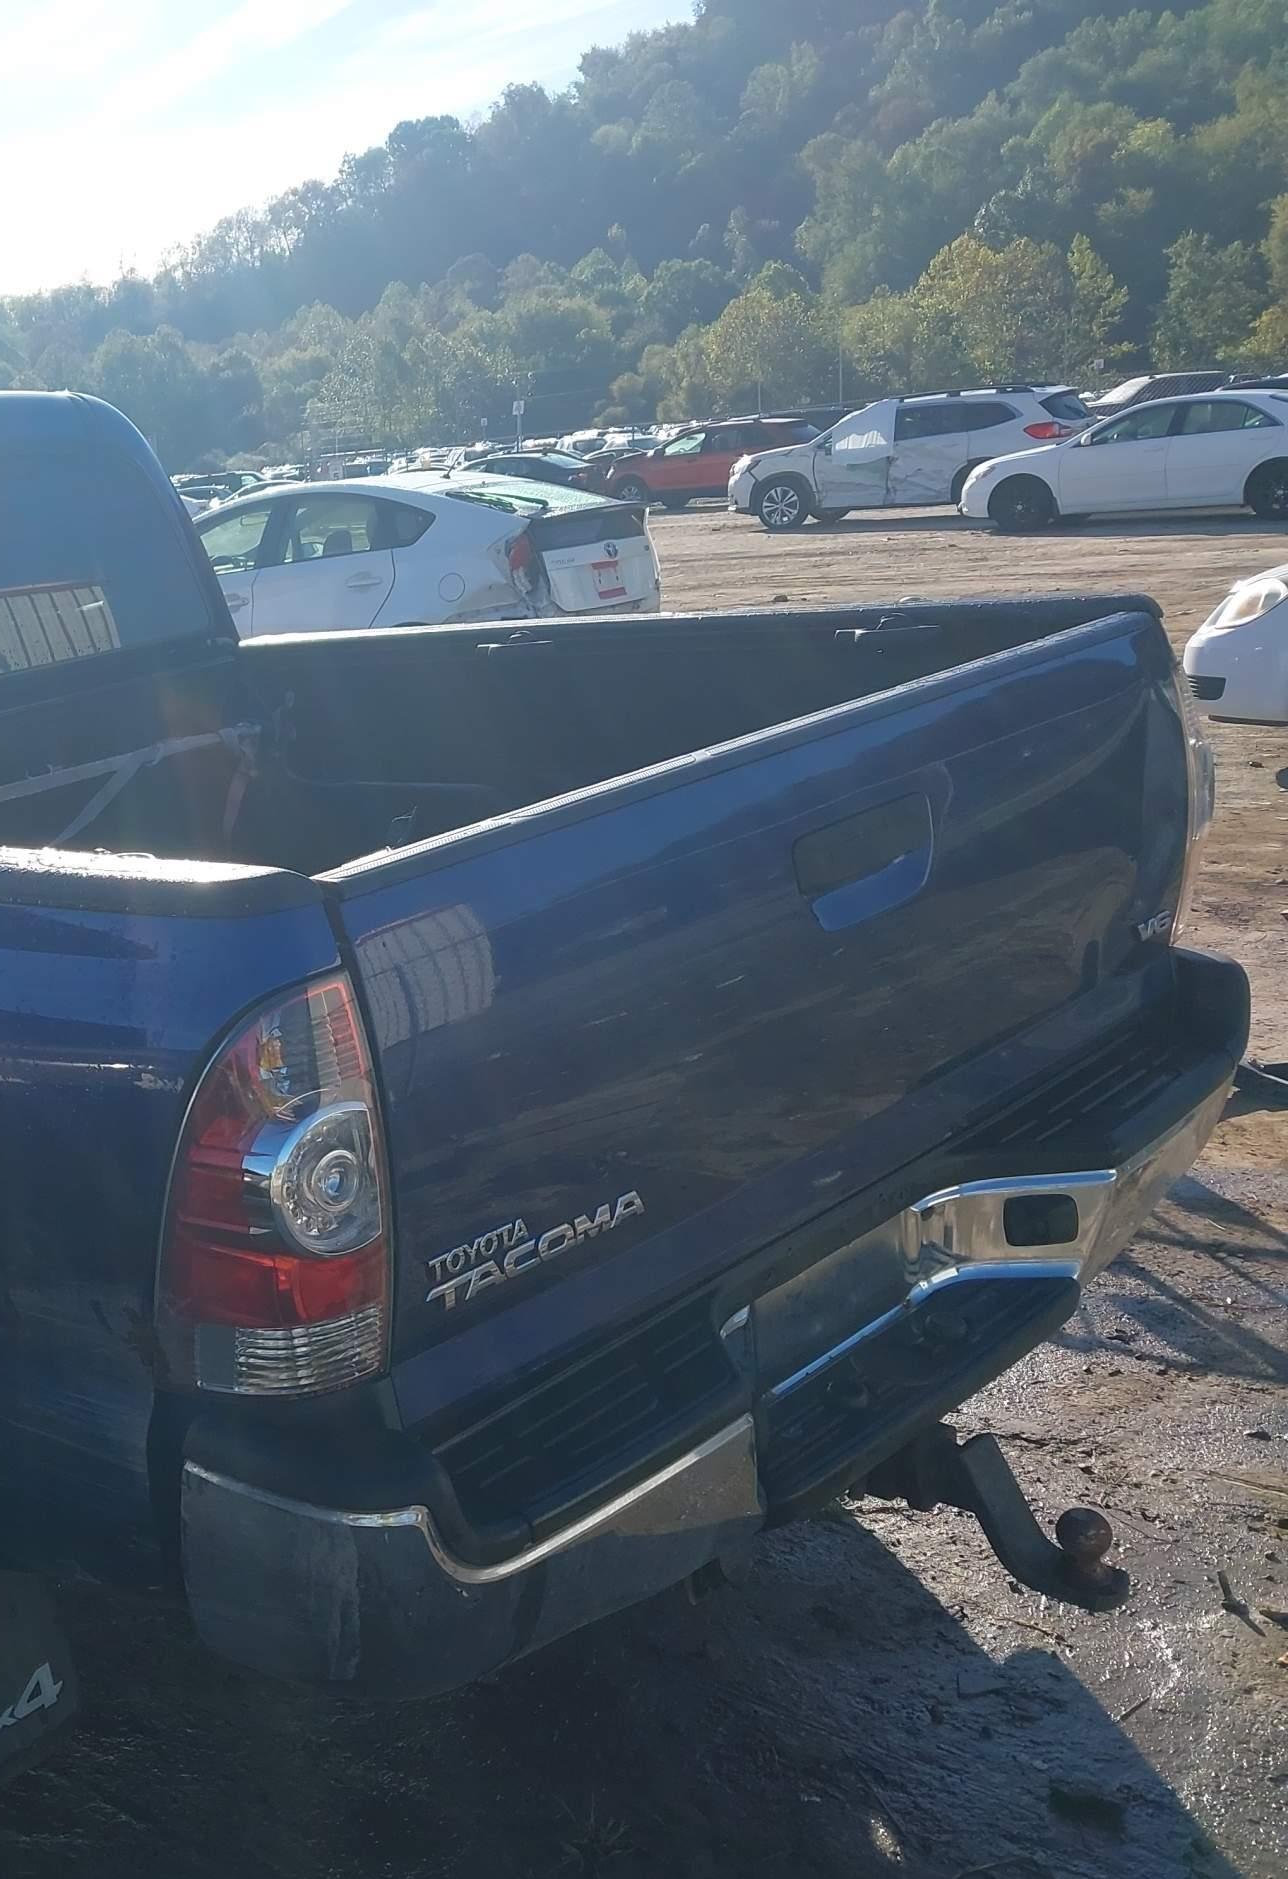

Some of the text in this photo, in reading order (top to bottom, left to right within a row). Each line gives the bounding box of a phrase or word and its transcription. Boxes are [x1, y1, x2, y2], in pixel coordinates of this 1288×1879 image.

[1137, 910, 1171, 941] V6
[426, 1190, 645, 1311] TACOMA
[427, 1218, 529, 1282] TOYOTA
